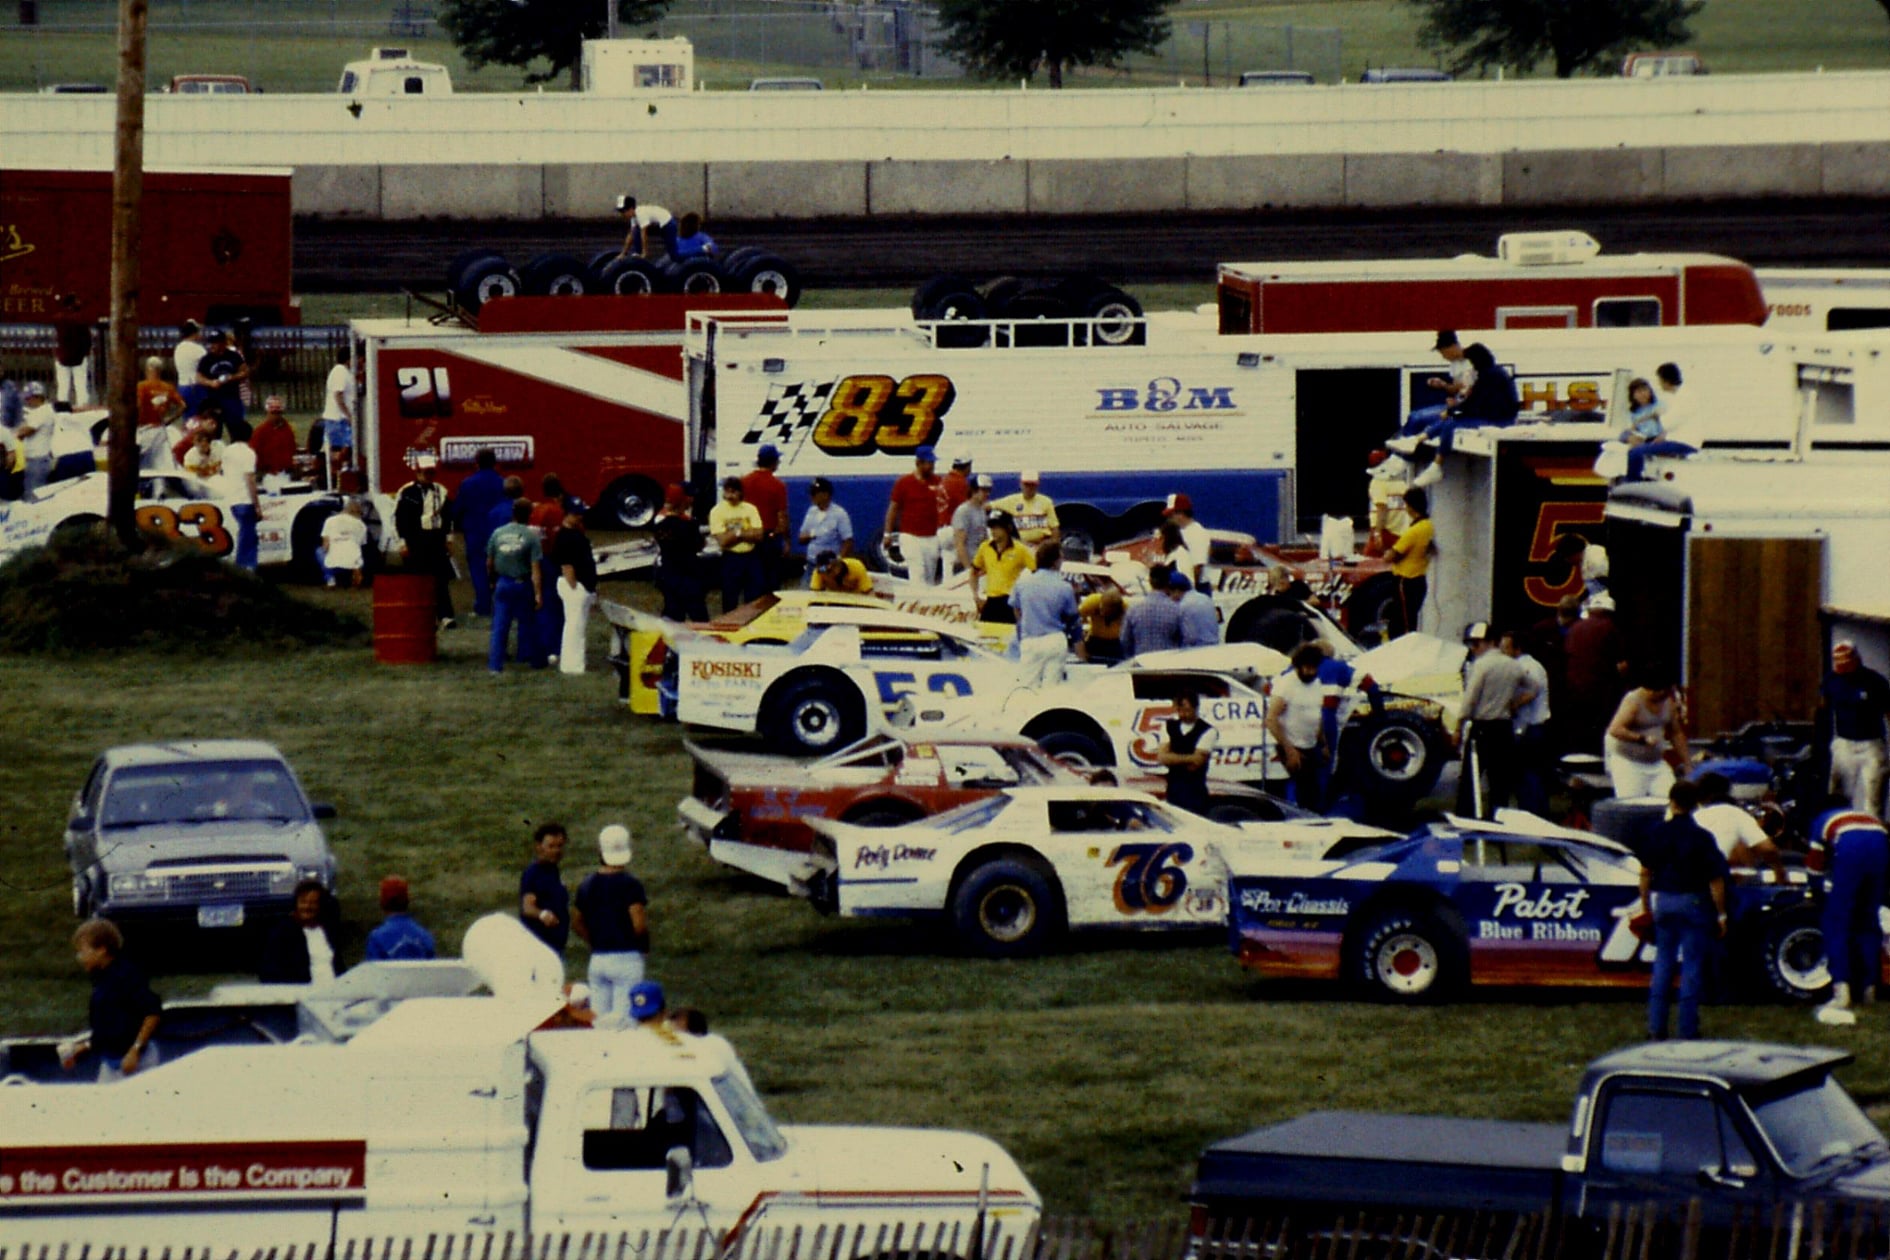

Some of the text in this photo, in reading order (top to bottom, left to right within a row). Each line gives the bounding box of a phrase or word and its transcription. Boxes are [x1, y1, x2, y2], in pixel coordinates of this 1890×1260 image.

[397, 366, 452, 416] 21
[812, 374, 956, 456] 83
[1105, 842, 1195, 915] 76
[1492, 883, 1591, 918] Pabst
[1479, 920, 1601, 941] Blue Ribbon
[19, 1169, 57, 1192] the
[62, 1167, 174, 1191] Customer
[203, 1165, 241, 1188] the
[246, 1162, 353, 1188] Company
